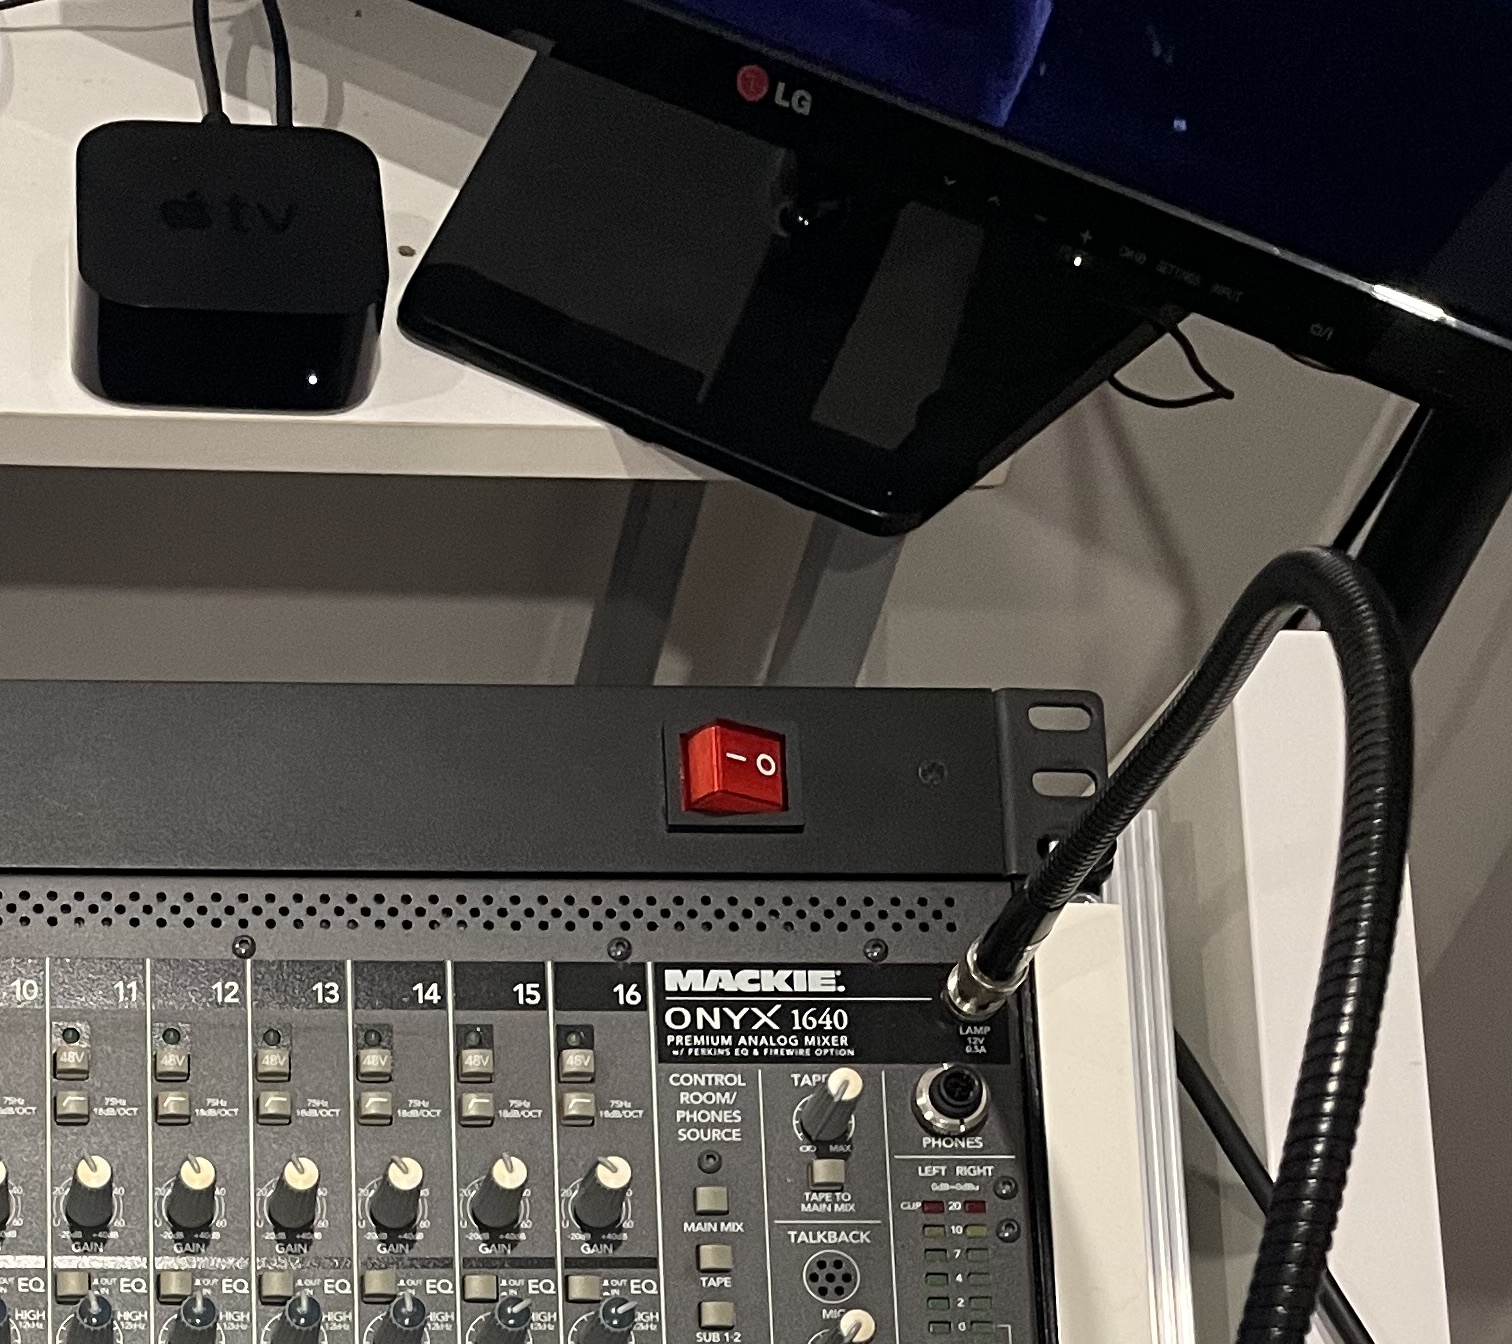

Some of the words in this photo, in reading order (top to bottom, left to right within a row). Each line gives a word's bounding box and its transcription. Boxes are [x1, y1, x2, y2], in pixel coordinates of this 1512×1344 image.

[775, 81, 813, 116] LG
[313, 982, 339, 1003] 13
[614, 984, 641, 1005] 16
[665, 1004, 781, 1029] ONYX
[792, 1008, 847, 1030] 1640
[960, 1026, 990, 1035] LAMP
[667, 1035, 732, 1046] PREMIUM
[738, 1035, 798, 1046] ANALOG
[805, 1036, 848, 1046] MIXER
[967, 1037, 984, 1046] 12V
[735, 1048, 748, 1056] EQ
[764, 1048, 810, 1056] FIREWIRE
[815, 1048, 854, 1056] OPTION
[161, 1052, 185, 1070] 48V
[669, 1074, 746, 1086] CONTROL
[680, 1092, 737, 1104] ROOM/
[677, 1110, 741, 1122] PHONES
[678, 1128, 741, 1141] SOURCE
[923, 1137, 983, 1148] PHONES
[918, 1166, 946, 1176] LEFT
[956, 1166, 994, 1176] RIGHT
[804, 1192, 832, 1201] TAPE
[835, 1192, 851, 1201] TO
[801, 1203, 831, 1212] MAIN
[834, 1204, 855, 1212] MIX
[949, 1201, 961, 1210] 20
[684, 1222, 717, 1232] MAIN
[721, 1222, 744, 1232] MIX
[787, 1231, 870, 1243] TALKBACK
[528, 1279, 556, 1294] EQ
[700, 1277, 731, 1287] TAPE
[696, 1332, 720, 1342] SUB
[724, 1332, 741, 1342] 1-2
